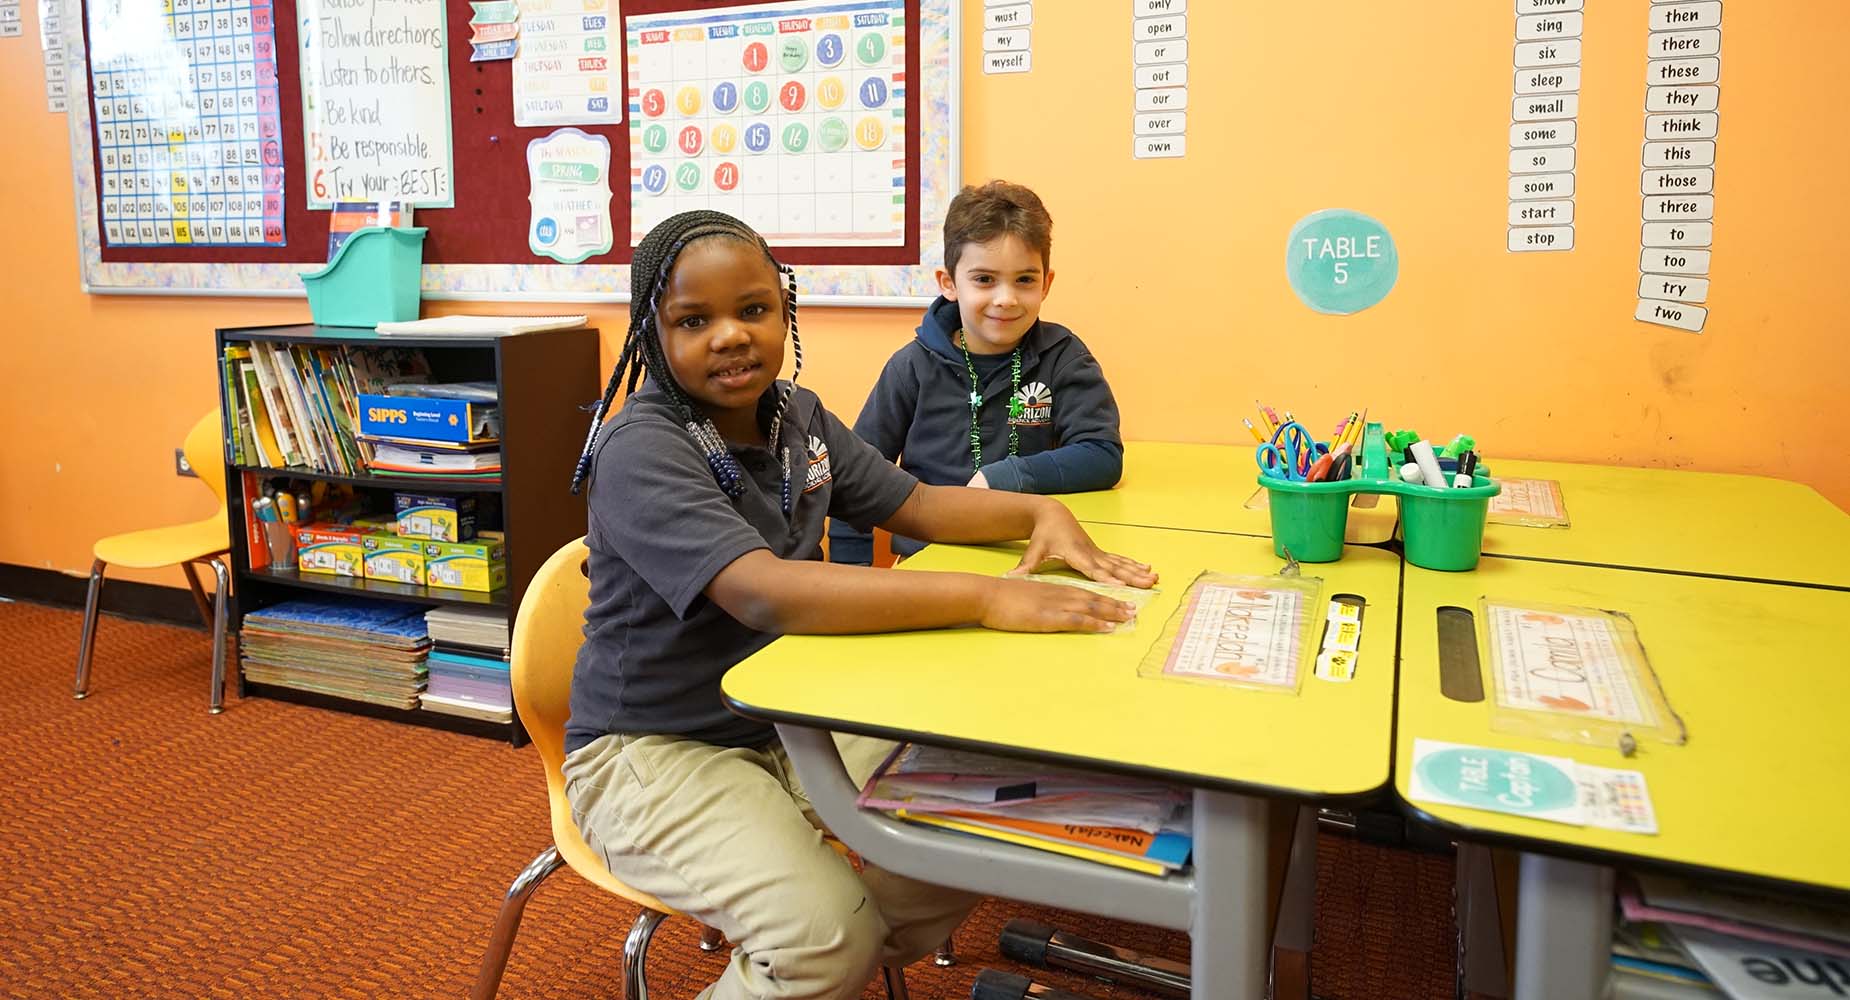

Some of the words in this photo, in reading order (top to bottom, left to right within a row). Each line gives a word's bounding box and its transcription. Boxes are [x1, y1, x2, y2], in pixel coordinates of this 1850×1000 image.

[179, 22, 190, 32] 36
[198, 20, 208, 31] 37
[217, 19, 228, 29] 38
[237, 17, 248, 28] 39
[256, 16, 268, 25] 40
[858, 14, 886, 26] SATURDAY
[995, 11, 1018, 23] must
[1666, 10, 1699, 24] then
[320, 16, 360, 48] Follow
[1148, 24, 1172, 36] open
[1536, 19, 1563, 33] sing
[998, 35, 1012, 46] my
[1662, 36, 1700, 52] there
[200, 46, 211, 57] 47
[219, 45, 230, 55] 48
[238, 44, 250, 55] 49
[258, 42, 270, 52] 50
[752, 48, 758, 66] 1
[824, 38, 834, 58] 3
[866, 38, 875, 58] 4
[1154, 48, 1166, 58] or
[1538, 47, 1557, 60] six
[992, 56, 1023, 68] myself
[322, 58, 358, 87] Listen
[364, 56, 378, 84] to
[380, 56, 436, 85] others.
[1152, 70, 1170, 82] out
[1660, 64, 1700, 79] these
[100, 81, 108, 90] 51
[115, 80, 124, 90] 52
[202, 72, 212, 83] 57
[221, 72, 232, 82] 58
[240, 70, 252, 80] 59
[1531, 73, 1563, 88] sleep
[648, 93, 658, 112] 5
[722, 86, 729, 106] 7
[752, 87, 760, 105] 8
[788, 86, 798, 106] 9
[824, 84, 838, 102] 10
[868, 82, 880, 103] 11
[1152, 94, 1170, 104] our
[1666, 91, 1699, 106] they
[102, 106, 110, 116] 61
[117, 104, 127, 114] 62
[204, 98, 214, 109] 67
[222, 97, 233, 108] 68
[242, 96, 253, 107] 69
[326, 100, 346, 126] Be
[350, 98, 382, 126] kind
[1529, 100, 1564, 114] small
[1148, 118, 1172, 129] over
[1662, 118, 1702, 134] think
[104, 130, 112, 140] 71
[120, 129, 130, 140] 72
[136, 128, 147, 138] 73
[188, 126, 198, 136] 76
[205, 124, 216, 134] 77
[224, 124, 235, 134] 78
[243, 122, 255, 133] 79
[650, 130, 660, 148] 12
[685, 130, 696, 148] 13
[752, 128, 764, 146] 15
[789, 128, 802, 148] 16
[863, 123, 876, 142] 18
[1524, 129, 1557, 141] some
[331, 136, 350, 160] Be
[355, 133, 432, 166] responsible.
[1148, 142, 1171, 152] own
[1664, 146, 1692, 160] this
[107, 155, 114, 164] 81
[122, 154, 132, 164] 82
[226, 150, 237, 160] 88
[246, 149, 256, 160] 89
[265, 148, 278, 158] 90
[1532, 155, 1546, 166] so
[108, 180, 116, 189] 91
[122, 179, 132, 189] 92
[174, 177, 184, 187] 95
[192, 178, 202, 187] 96
[210, 176, 220, 186] 97
[228, 176, 240, 186] 98
[247, 175, 259, 185] 99
[314, 169, 330, 199] 6.
[330, 166, 353, 198] Try
[362, 174, 390, 198] your
[400, 167, 441, 197] BEST
[648, 168, 662, 188] 19
[680, 166, 697, 185] 20
[722, 167, 733, 186] 21
[1658, 174, 1698, 188] those
[1524, 182, 1554, 194] soon
[106, 204, 118, 213] 101
[122, 204, 135, 214] 102
[139, 203, 152, 213] 103
[174, 202, 187, 212] 105
[192, 202, 206, 212] 106
[210, 202, 224, 212] 107
[228, 202, 242, 212] 108
[248, 201, 261, 211] 109
[267, 200, 278, 210] 110
[1522, 207, 1556, 220] start
[1660, 200, 1698, 214] three
[110, 228, 118, 237] 111
[126, 228, 135, 237] 112
[142, 228, 152, 237] 113
[159, 228, 170, 237] 114
[176, 227, 186, 237] 115
[194, 227, 204, 236] 116
[212, 227, 222, 236] 117
[230, 227, 240, 236] 118
[249, 226, 260, 236] 119
[266, 226, 280, 236] 120
[1670, 228, 1685, 240] to
[1527, 232, 1555, 246] stop
[1302, 236, 1381, 260] TABLE
[1664, 255, 1686, 267] too
[1334, 262, 1349, 284] 5
[1662, 282, 1686, 297] try
[1655, 305, 1682, 322] two
[368, 407, 408, 424] SIPPS
[1460, 756, 1488, 793] TABLE
